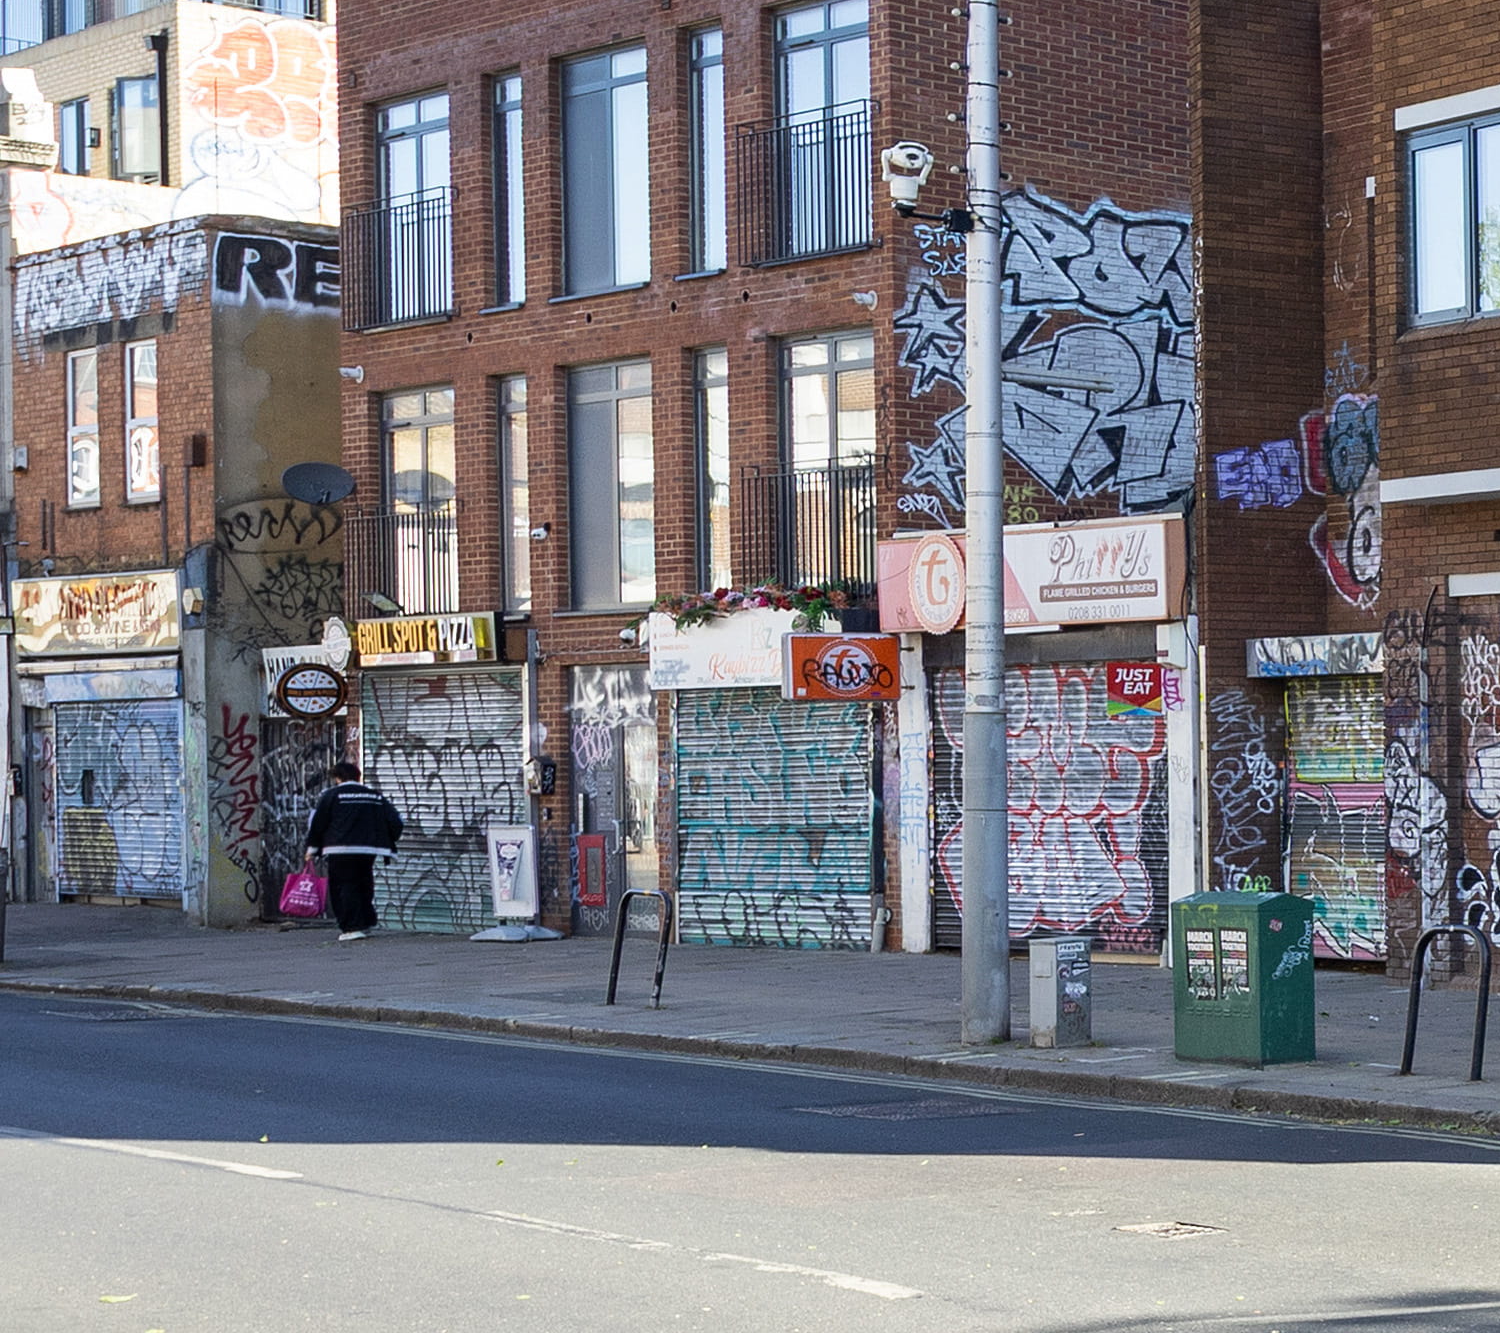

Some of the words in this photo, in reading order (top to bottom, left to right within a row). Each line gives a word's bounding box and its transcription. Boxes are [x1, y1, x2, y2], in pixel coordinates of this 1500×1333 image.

[1043, 587, 1065, 600] FLAME
[1065, 585, 1091, 599] GRILLED
[1091, 584, 1119, 597] CHICKEN
[1125, 582, 1156, 595] BURGERS
[1068, 606, 1087, 620] 0208
[1089, 605, 1105, 619] 331
[1106, 604, 1130, 618] 0011
[357, 621, 392, 655] GRILL
[393, 620, 425, 653] SPOT
[427, 620, 437, 651] &
[438, 616, 476, 652] PIZZA
[1114, 668, 1154, 684] JUST
[1123, 681, 1154, 696] EAT
